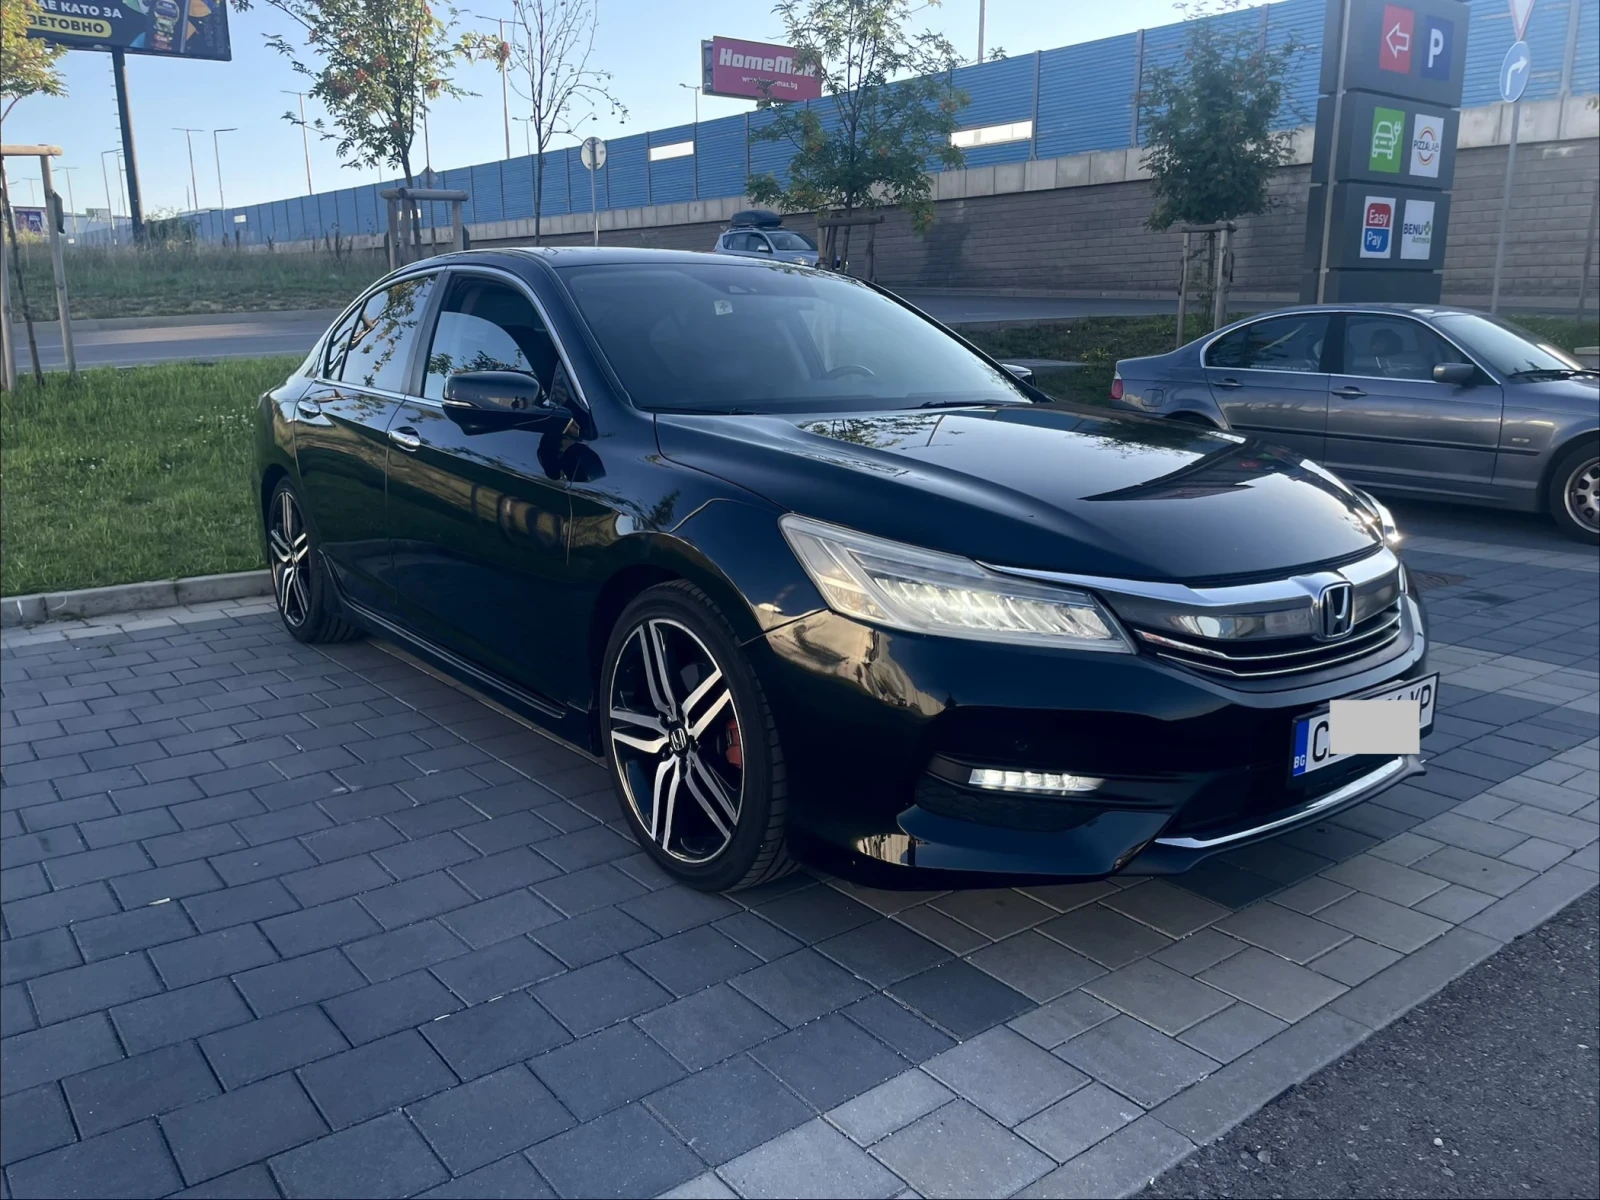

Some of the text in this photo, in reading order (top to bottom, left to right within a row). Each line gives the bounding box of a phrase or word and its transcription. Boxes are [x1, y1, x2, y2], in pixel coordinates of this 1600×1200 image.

[60, 2, 100, 16] КАТО
[102, 7, 123, 19] ЗА
[27, 14, 105, 34] ВЕТОВНО
[1368, 209, 1389, 227] Easy
[1403, 223, 1424, 235] BENU
[1366, 231, 1383, 249] Pay
[1293, 754, 1306, 769] BG
